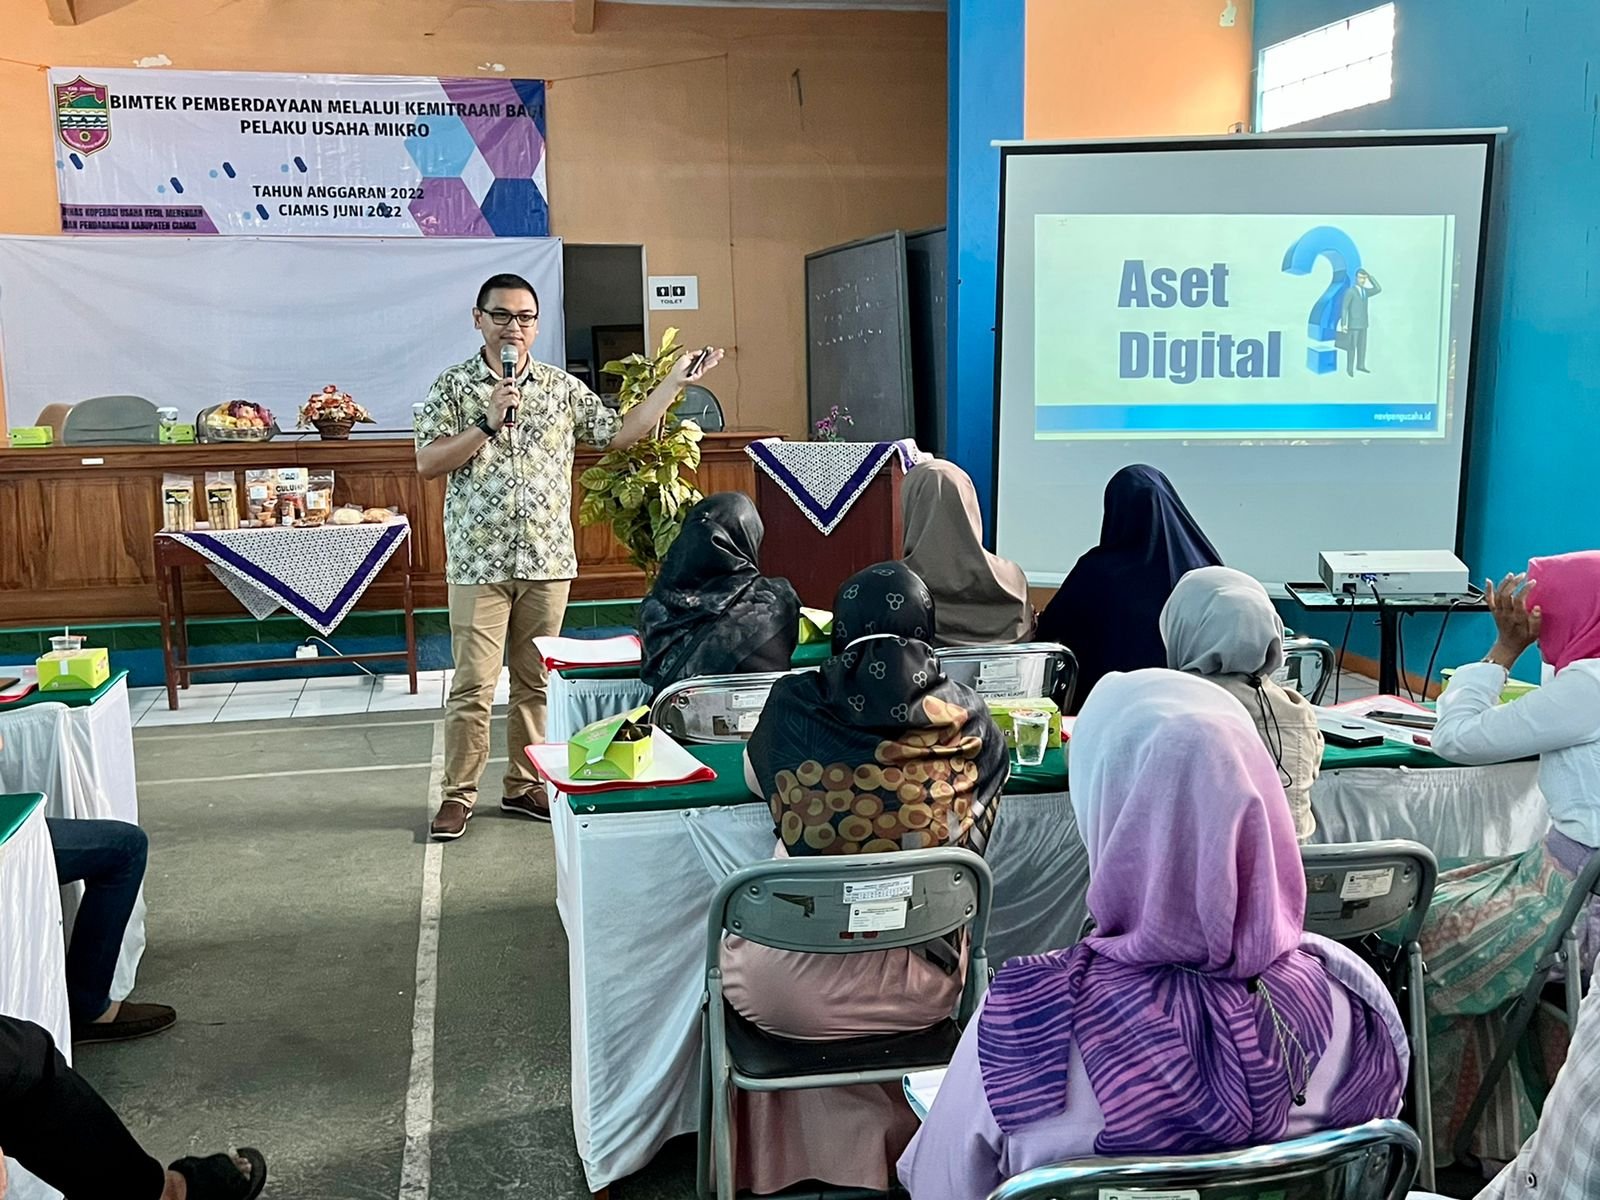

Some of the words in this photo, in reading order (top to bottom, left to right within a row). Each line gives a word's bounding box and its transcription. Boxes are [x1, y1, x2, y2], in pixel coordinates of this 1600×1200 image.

[110, 95, 177, 110] BIMTEK
[182, 96, 322, 113] PEMBERDAYAAN
[328, 100, 399, 115] MELALUI
[405, 101, 500, 117] KEMITRAAN
[505, 103, 543, 119] BAGI
[240, 120, 306, 135] PELAKU
[312, 121, 369, 136] USAHA
[374, 123, 429, 137] MIKRO
[253, 185, 302, 197] TAHUN
[307, 186, 386, 199] ANGGARAN
[390, 187, 424, 199] 2022
[278, 204, 329, 216] CIAMIS
[333, 204, 363, 219] JUNI
[367, 205, 402, 217] 2022
[1117, 258, 1230, 308] Aset
[1119, 330, 1282, 385] Digital
